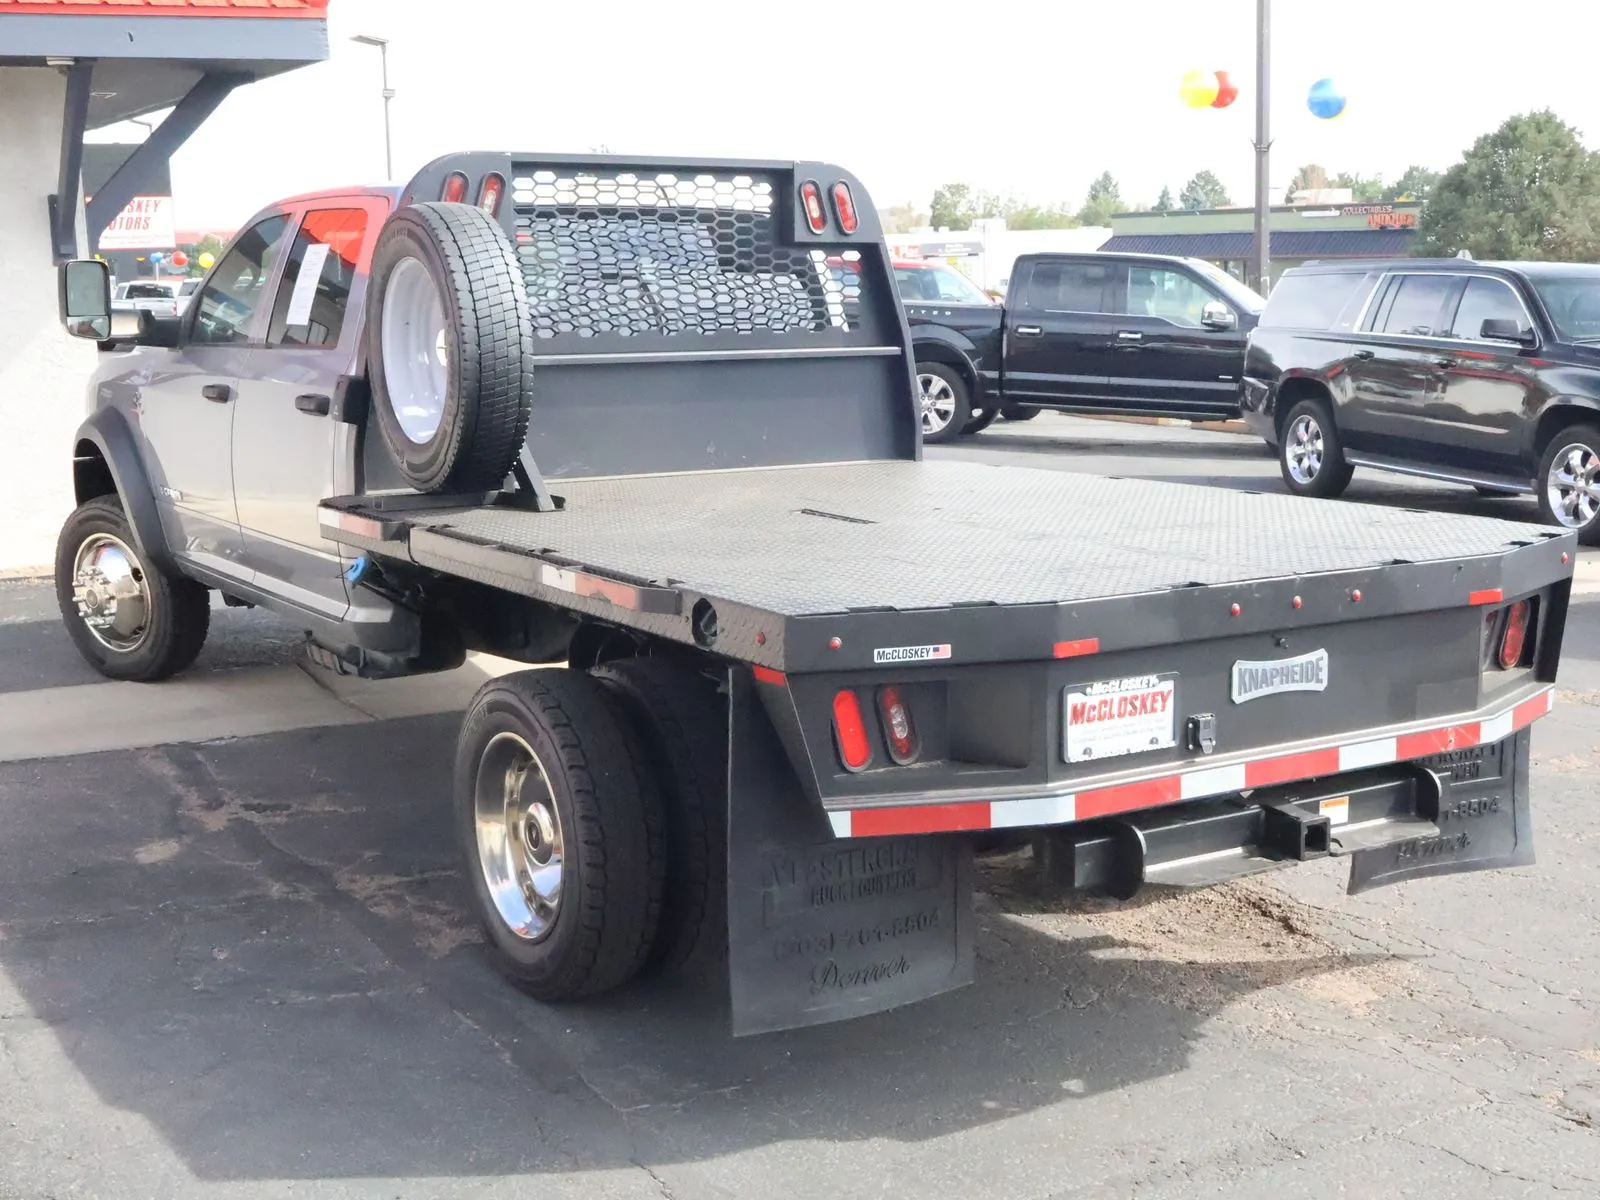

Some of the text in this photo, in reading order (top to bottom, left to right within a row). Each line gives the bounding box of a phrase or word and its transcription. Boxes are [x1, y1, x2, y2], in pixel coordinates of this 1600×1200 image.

[876, 647, 931, 661] McCLOSKEY
[1237, 656, 1324, 697] KNAPHEIDE
[1069, 689, 1172, 726] McCLOSKEY
